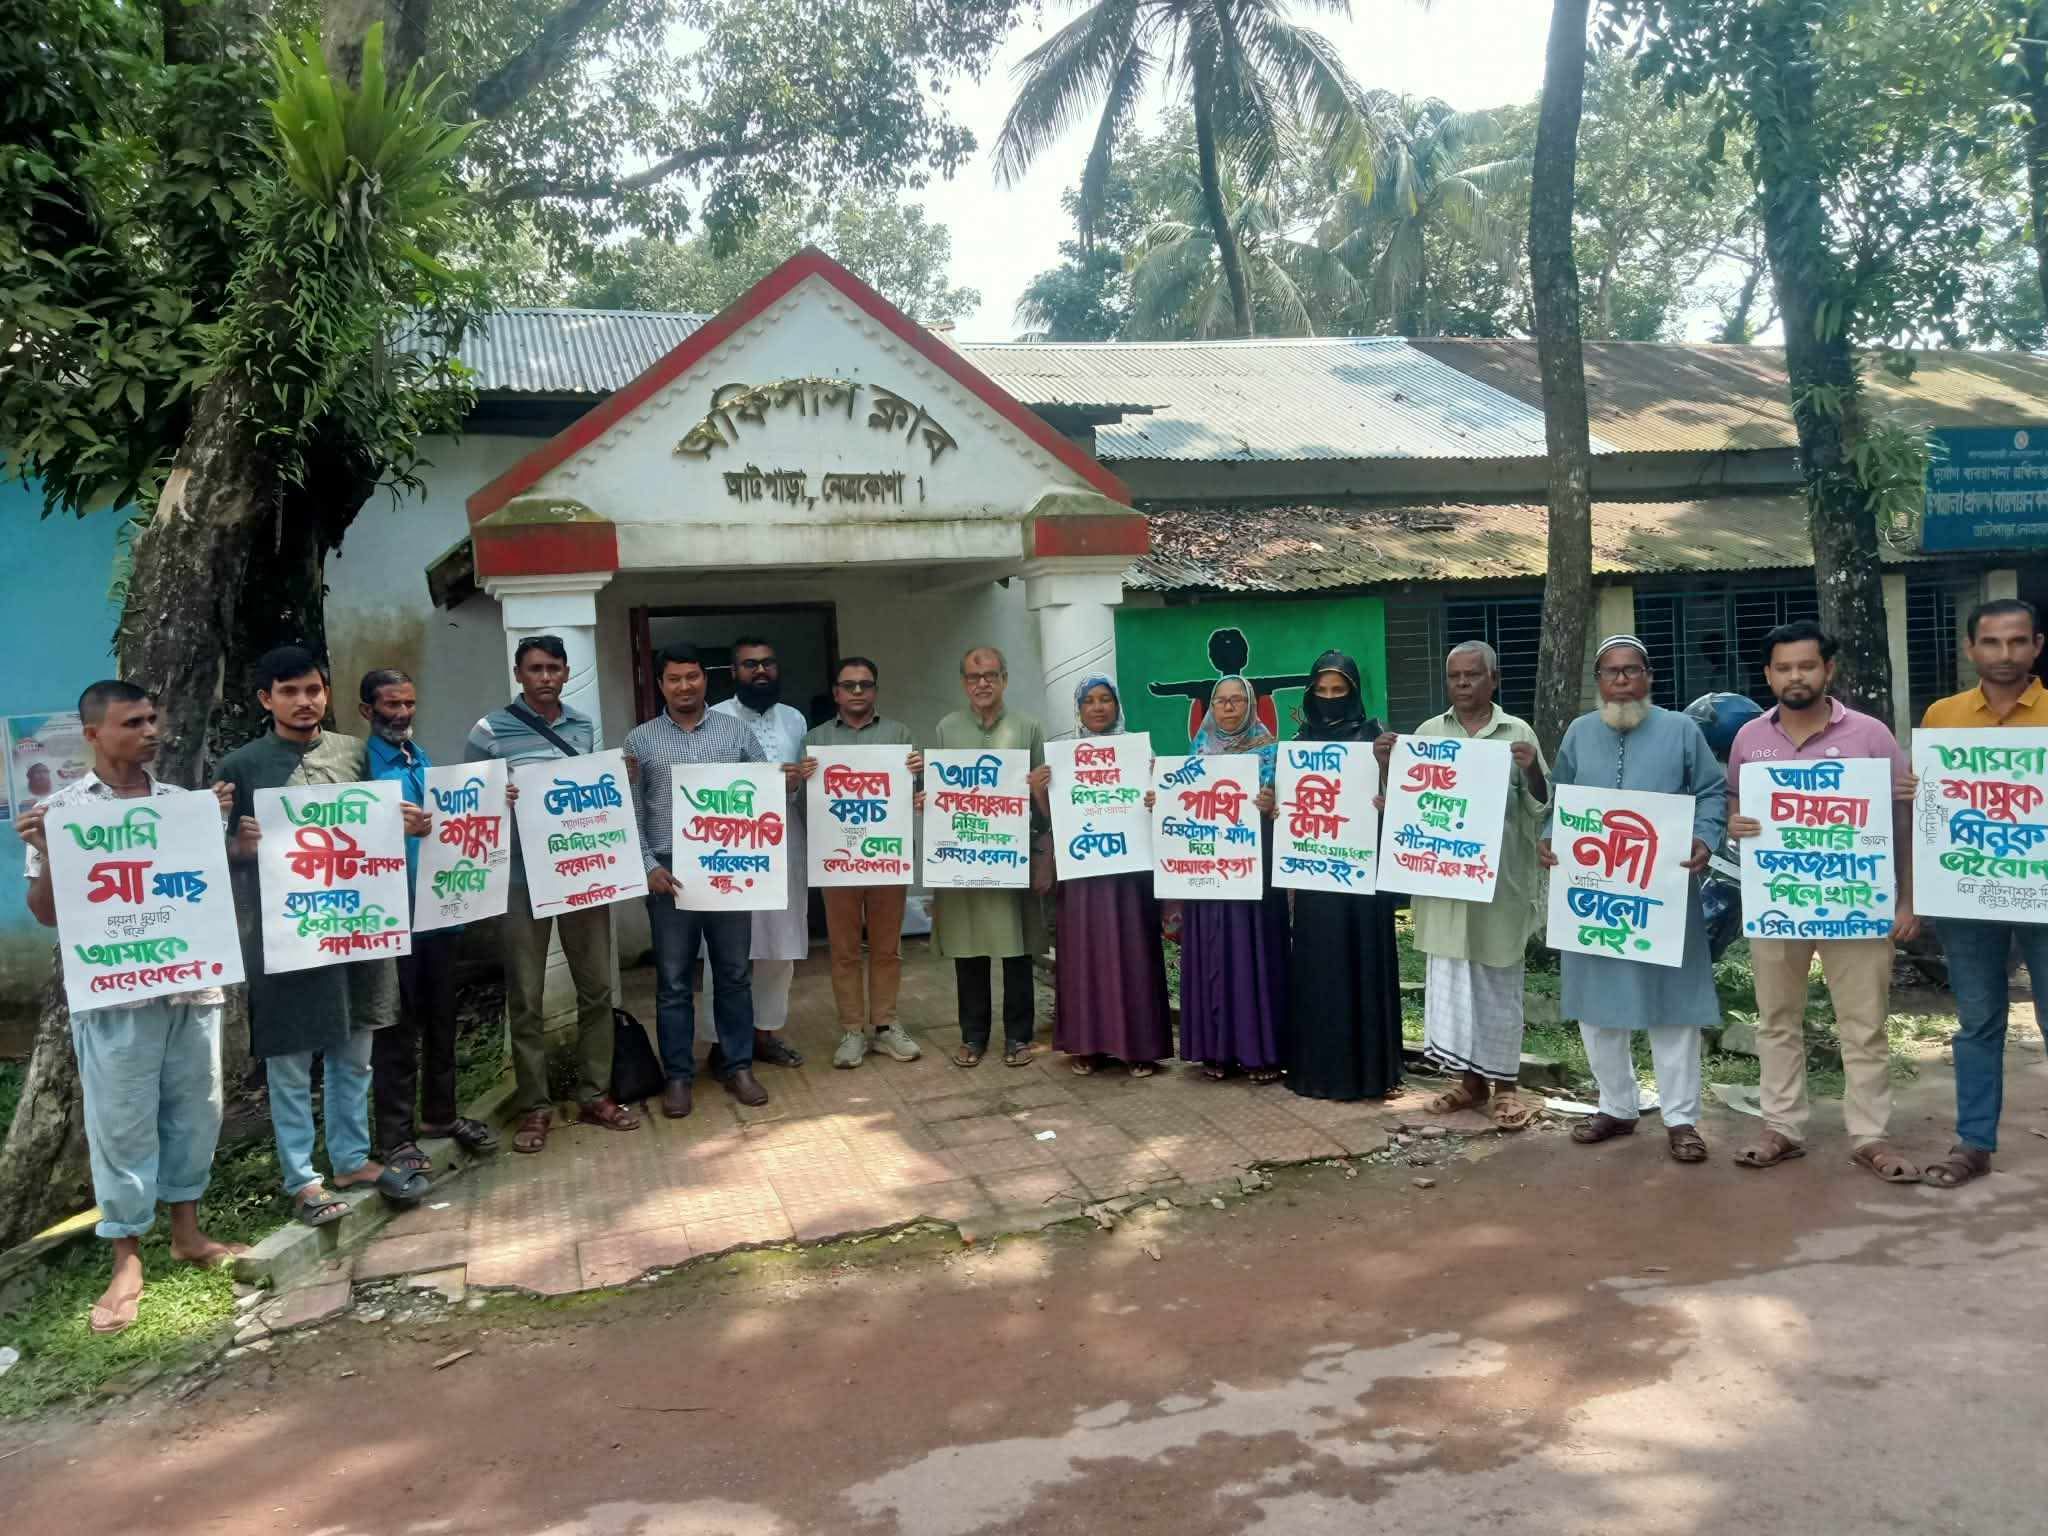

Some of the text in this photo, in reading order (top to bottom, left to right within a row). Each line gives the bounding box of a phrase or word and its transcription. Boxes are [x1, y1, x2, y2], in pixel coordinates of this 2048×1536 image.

[1288, 744, 1348, 773] আমি
[1407, 740, 1461, 763] আমি
[1929, 745, 2047, 779] আমরা
[824, 764, 890, 800] হিজল
[929, 755, 1002, 788] আমি
[1159, 756, 1206, 790] আমি
[1400, 763, 1457, 792] ব্যাঙ
[1766, 761, 1845, 791] আমি
[280, 789, 380, 827] আমি
[430, 777, 485, 816] আমি
[544, 774, 622, 815] মৌমাছি
[680, 779, 757, 818] আমি
[829, 799, 888, 825] করচ
[1178, 779, 1248, 824] পাখি
[1770, 792, 1870, 828] চায়না
[1939, 779, 2044, 824] শামুক
[64, 807, 162, 852] আমি
[682, 812, 784, 849] প্রজাপতি
[1421, 810, 1452, 832] খাই
[1558, 806, 1603, 833] আমি
[1950, 808, 2048, 857] ঝিনুক
[440, 813, 501, 864] শকুন
[861, 837, 904, 858] বোন
[1069, 822, 1127, 860] কেঁচো
[1394, 824, 1486, 858] কীটনাশকে
[285, 826, 366, 887] কীট
[926, 848, 977, 865] ব্যবহার
[1160, 858, 1216, 875] আমাকে
[1393, 851, 1438, 875] আমি
[88, 861, 207, 904] মা মাছ
[1824, 880, 1881, 909] খাই
[1567, 887, 1664, 929] ভালো
[74, 937, 189, 966] আমাকে
[1577, 917, 1636, 954] নেই
